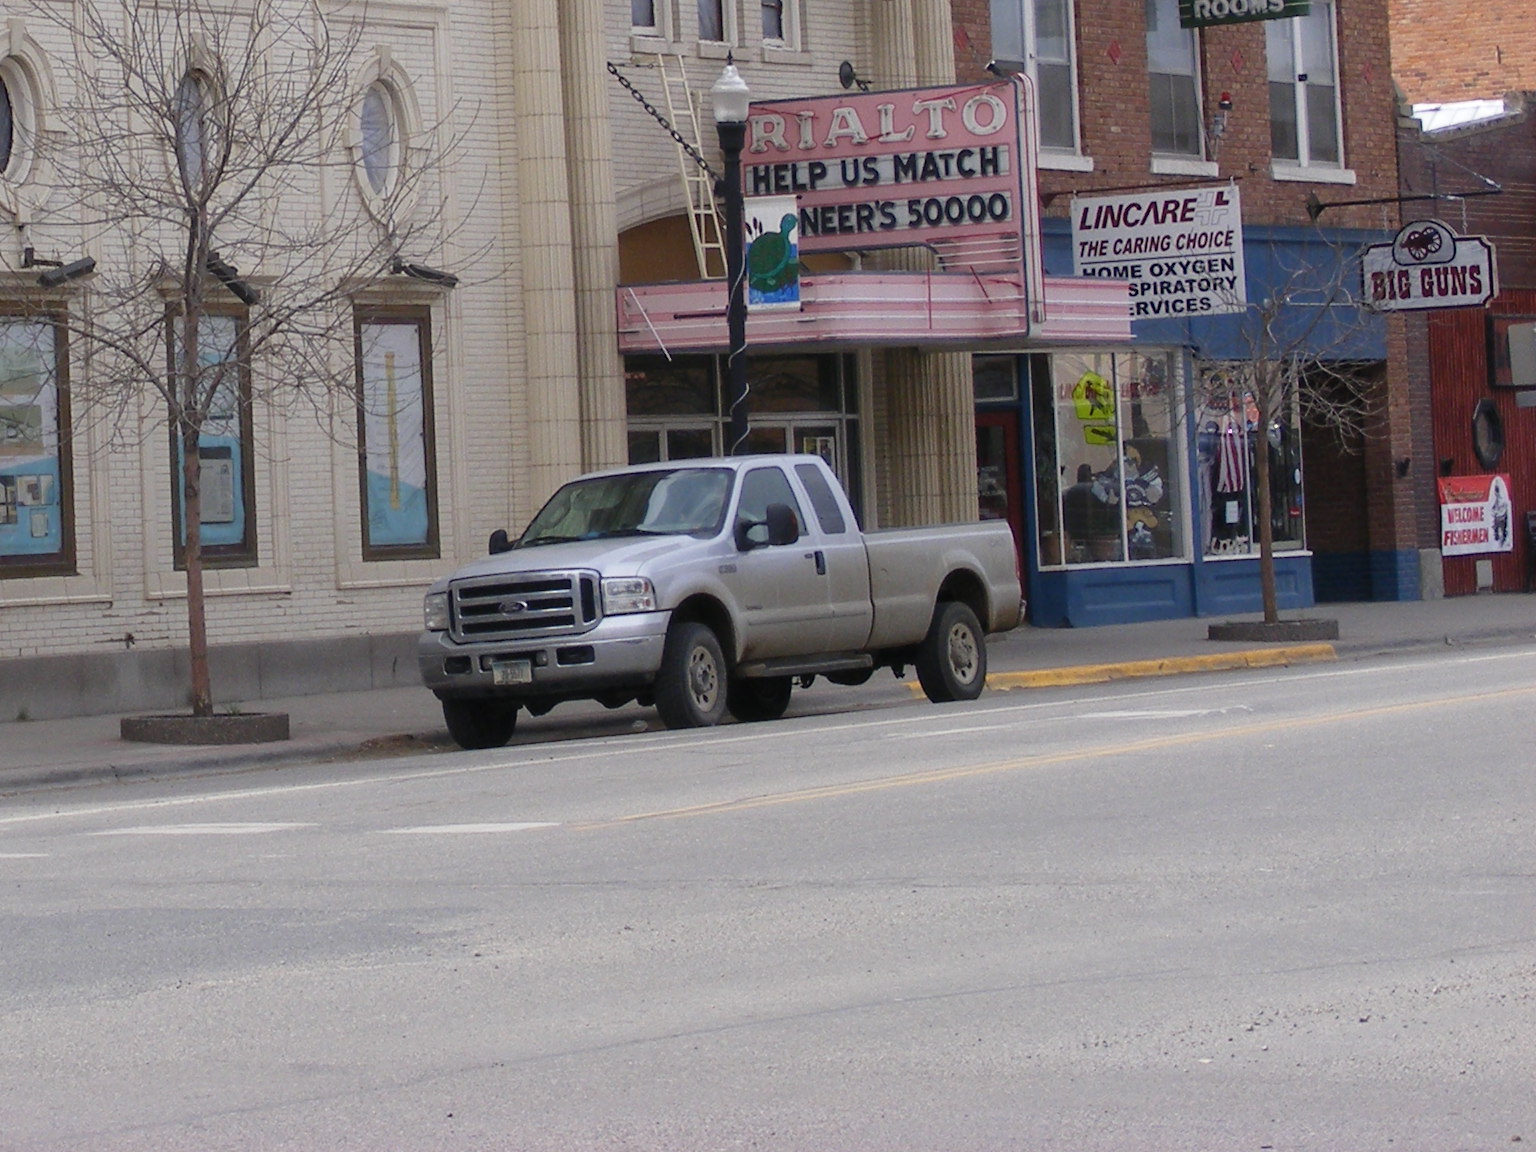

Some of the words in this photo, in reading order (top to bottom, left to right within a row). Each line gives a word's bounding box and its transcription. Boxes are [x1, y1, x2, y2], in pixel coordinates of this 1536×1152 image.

[748, 94, 1008, 154] RIALTO
[753, 161, 827, 193] HELP
[840, 156, 880, 187] US
[893, 146, 1000, 183] MATCH
[907, 193, 1009, 230] 50000
[1079, 198, 1197, 231] LINCARE
[1079, 240, 1109, 258] THE
[1113, 234, 1172, 255] CARING
[1176, 230, 1235, 250] CHOICE
[1082, 264, 1142, 279] HOME
[1149, 257, 1235, 278] OXYGEN
[1128, 276, 1237, 298] SPIRATORY
[1371, 269, 1411, 301] BIG
[1420, 264, 1483, 298] GUNS
[1129, 297, 1212, 316] RVICES
[1447, 506, 1485, 524] WELCOME
[1444, 527, 1489, 546] FISHERMEN
